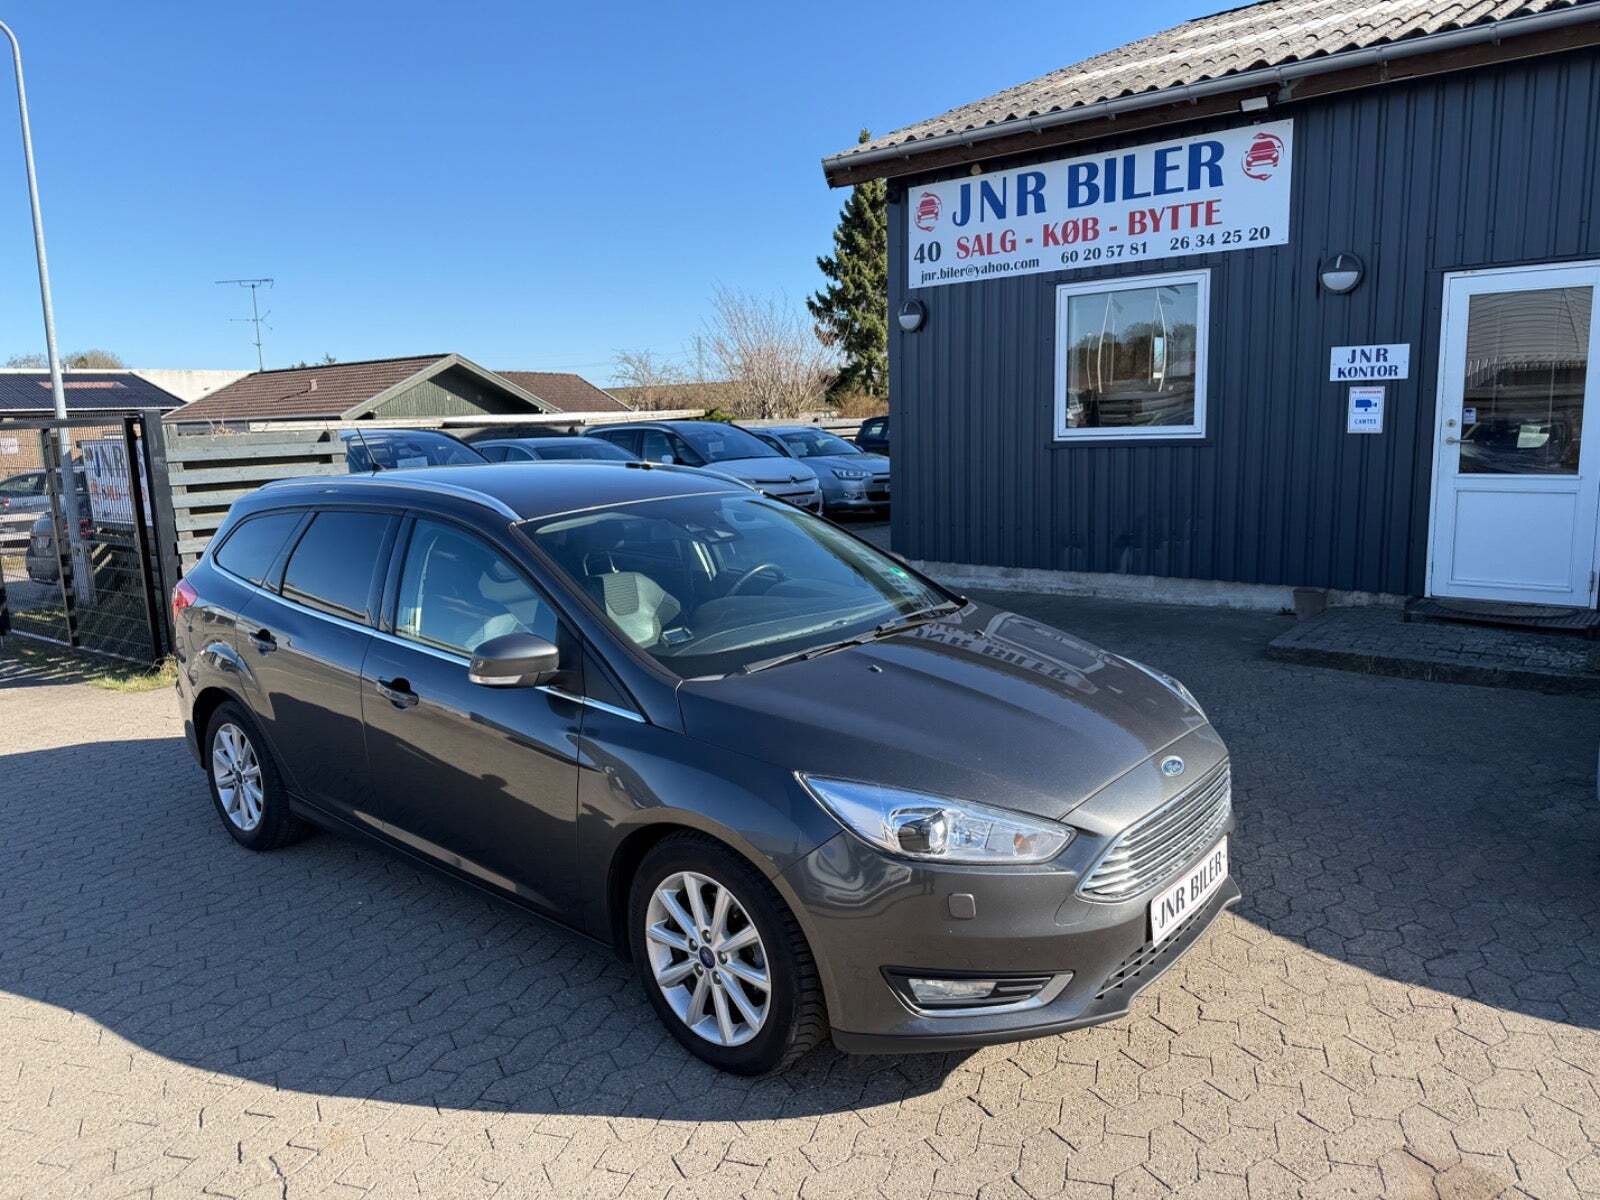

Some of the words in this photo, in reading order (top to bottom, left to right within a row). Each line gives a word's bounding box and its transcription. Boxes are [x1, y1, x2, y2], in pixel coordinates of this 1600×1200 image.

[952, 171, 1047, 227] JNR
[1067, 140, 1225, 209] BILER
[956, 229, 1017, 260] SALG
[1042, 216, 1100, 248] KØB
[1127, 199, 1223, 236] BYTTE
[1060, 250, 1079, 264] 60
[1083, 248, 1101, 261] 20
[1106, 244, 1124, 258] 57
[1130, 241, 1147, 255] 81
[1169, 236, 1190, 251] 26
[1195, 232, 1215, 247] 34
[1222, 229, 1242, 244] 25
[1249, 226, 1270, 241] 20
[913, 241, 942, 264] 40
[920, 258, 1040, 284] jnr.biler@yahoo.com
[1337, 364, 1399, 379] KONTOR
[1347, 347, 1389, 364] JNR
[1158, 886, 1186, 929] JNR
[1190, 850, 1222, 902] BILER
